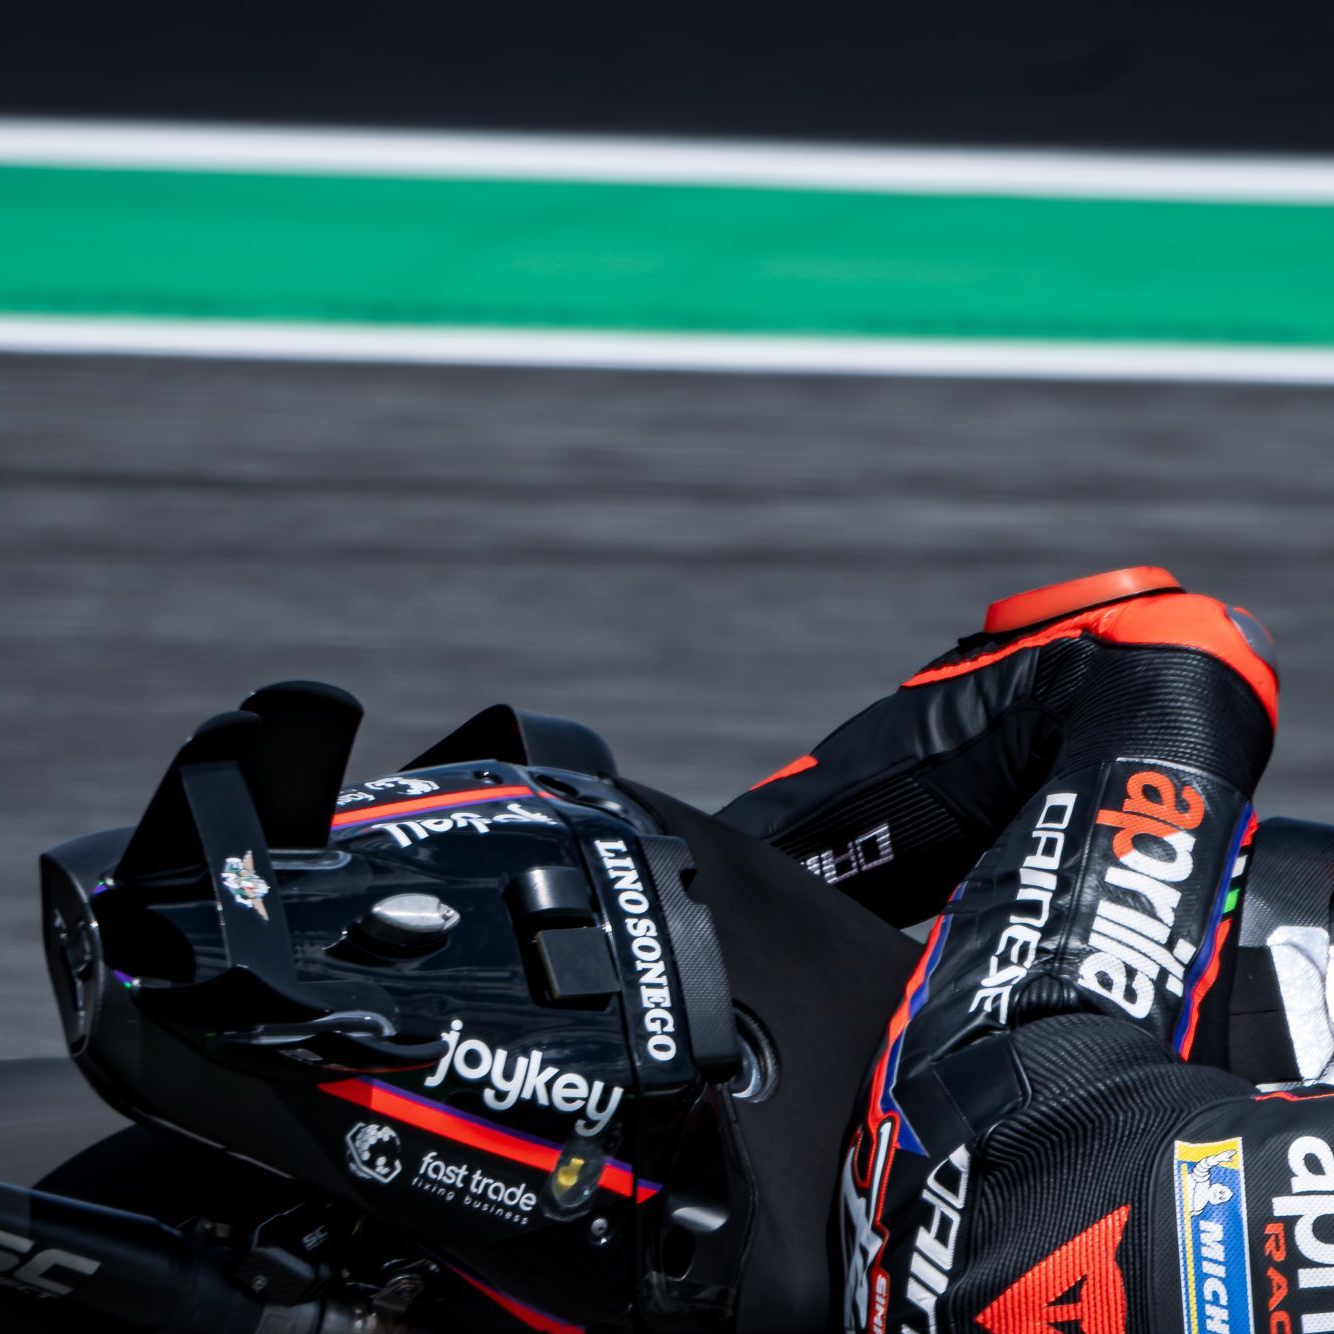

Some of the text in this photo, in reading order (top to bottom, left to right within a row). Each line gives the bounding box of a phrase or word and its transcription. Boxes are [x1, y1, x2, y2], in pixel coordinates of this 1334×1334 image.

[969, 793, 1077, 1024] DAINESE
[1078, 771, 1205, 1019] aprilia
[424, 1020, 623, 1136] joykey
[419, 1152, 537, 1211] fast trade
[463, 1196, 529, 1225] business
